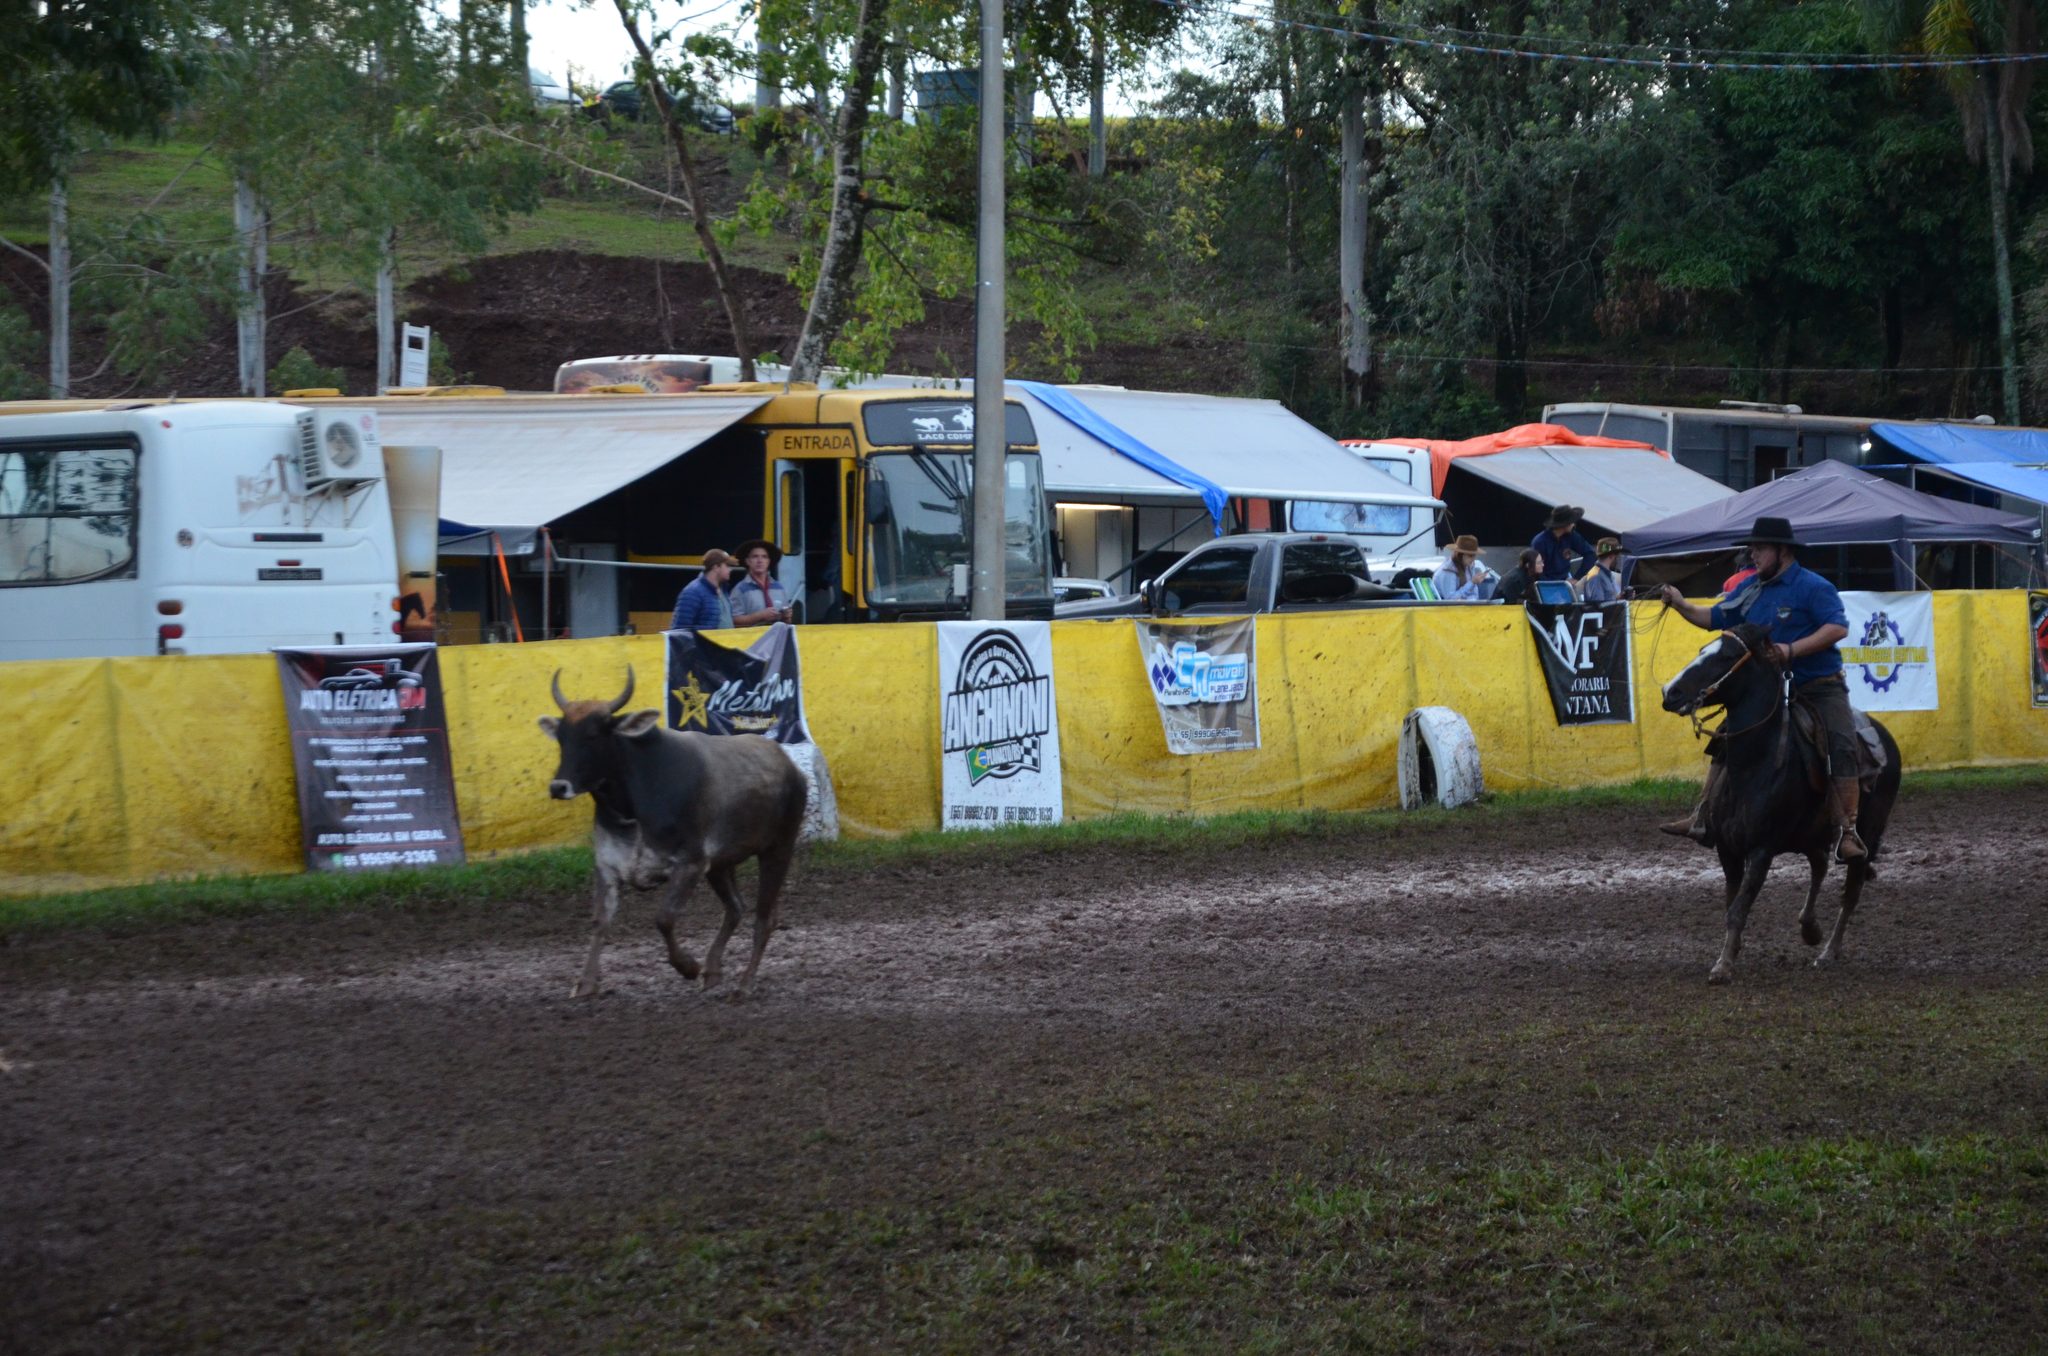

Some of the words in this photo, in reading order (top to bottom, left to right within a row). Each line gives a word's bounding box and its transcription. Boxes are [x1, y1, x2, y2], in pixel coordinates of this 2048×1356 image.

[784, 435, 851, 450] ENTRADA
[1566, 694, 1611, 714] NTANA
[945, 678, 1049, 752] ANGHINONI
